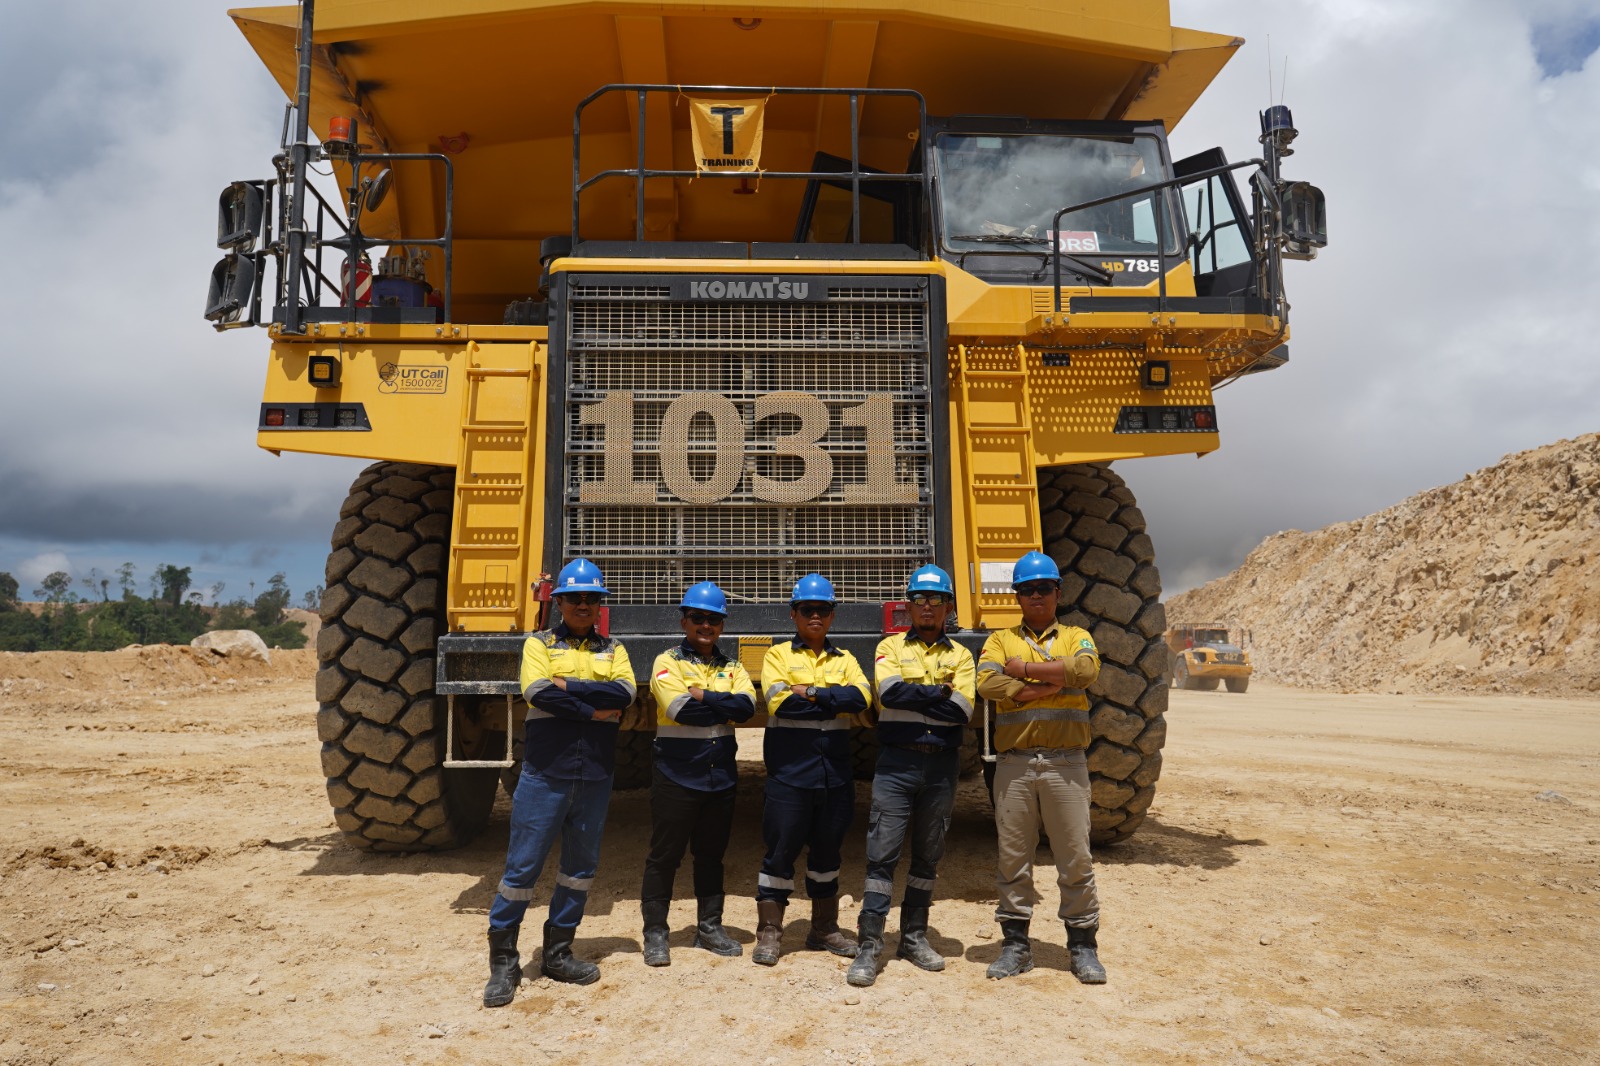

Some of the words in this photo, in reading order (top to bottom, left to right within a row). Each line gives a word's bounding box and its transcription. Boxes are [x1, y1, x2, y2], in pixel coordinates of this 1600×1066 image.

[710, 107, 745, 155] T
[702, 158, 754, 167] TRAINING
[690, 276, 809, 300] KOMATSU
[579, 390, 919, 505] 1031
